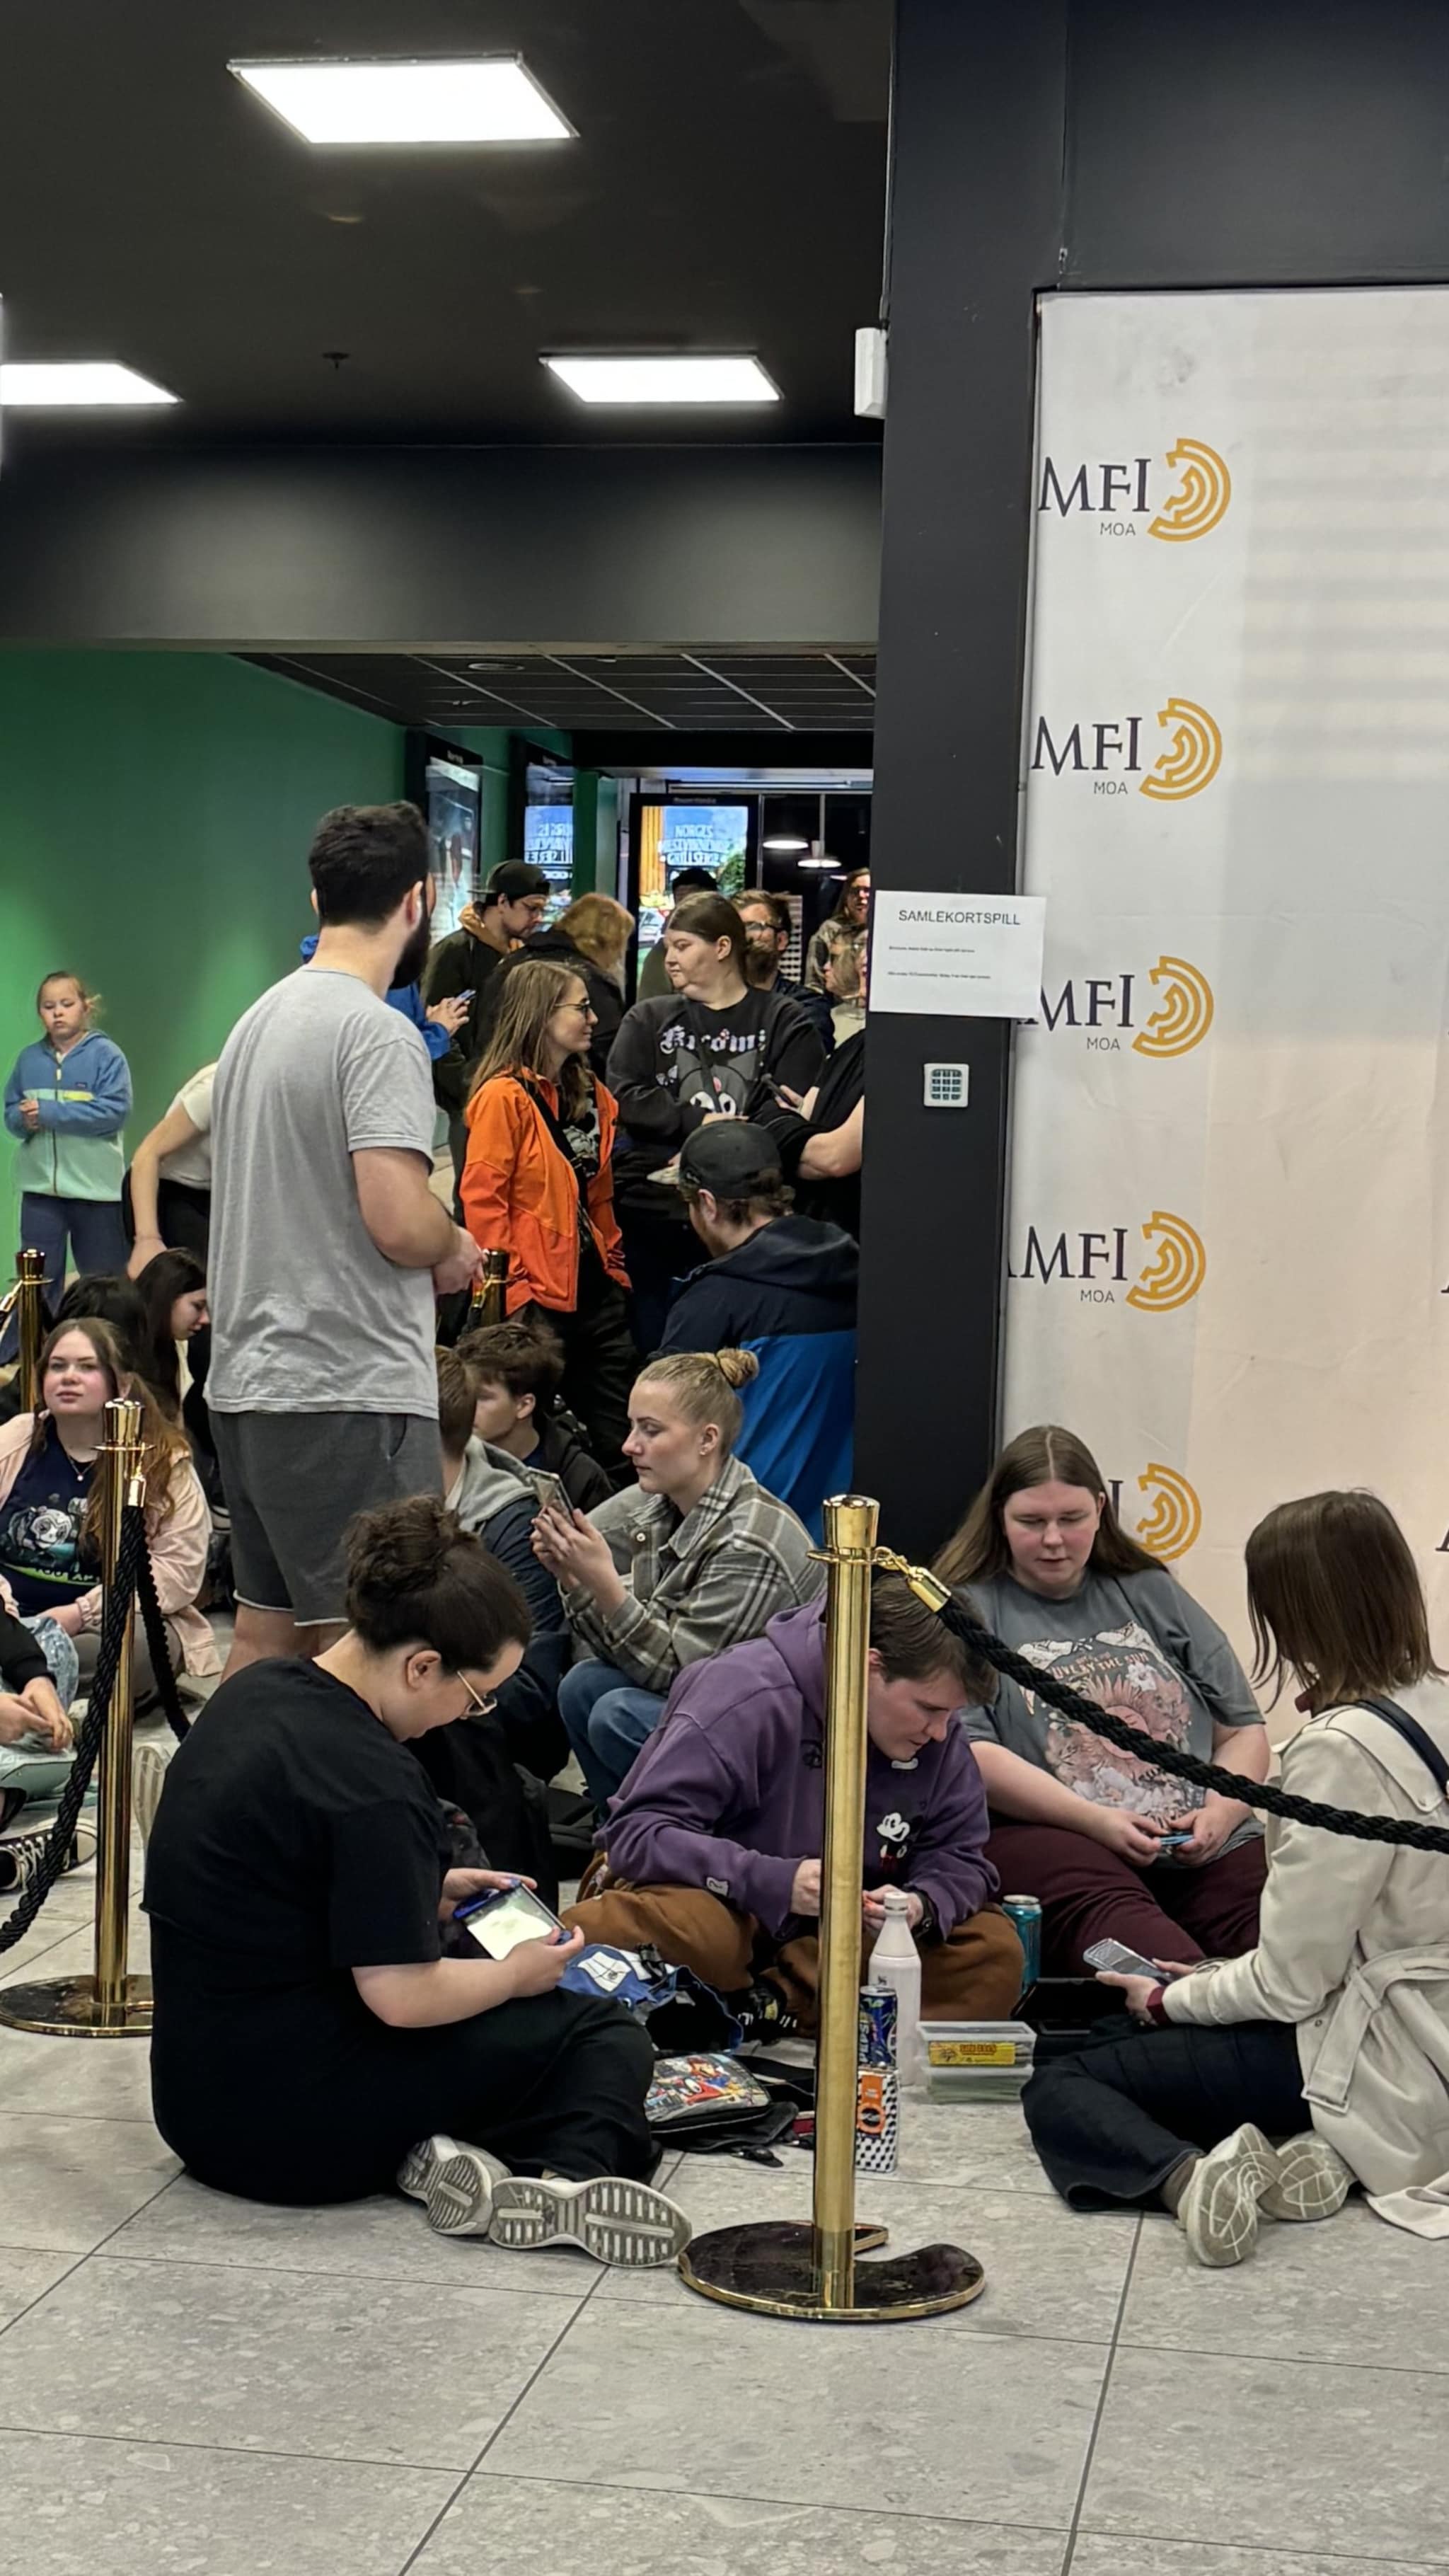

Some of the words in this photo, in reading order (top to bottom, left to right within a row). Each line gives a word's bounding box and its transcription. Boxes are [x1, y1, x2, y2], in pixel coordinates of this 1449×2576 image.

[1100, 522, 1136, 536] MOA
[1094, 781, 1128, 794] MOA
[899, 909, 1020, 926] SAMLEKORTSPILL
[1017, 974, 1135, 1032] MFI
[1087, 1037, 1120, 1051] MOA
[1008, 1226, 1128, 1284] MFI
[1080, 1289, 1115, 1303] MOA
